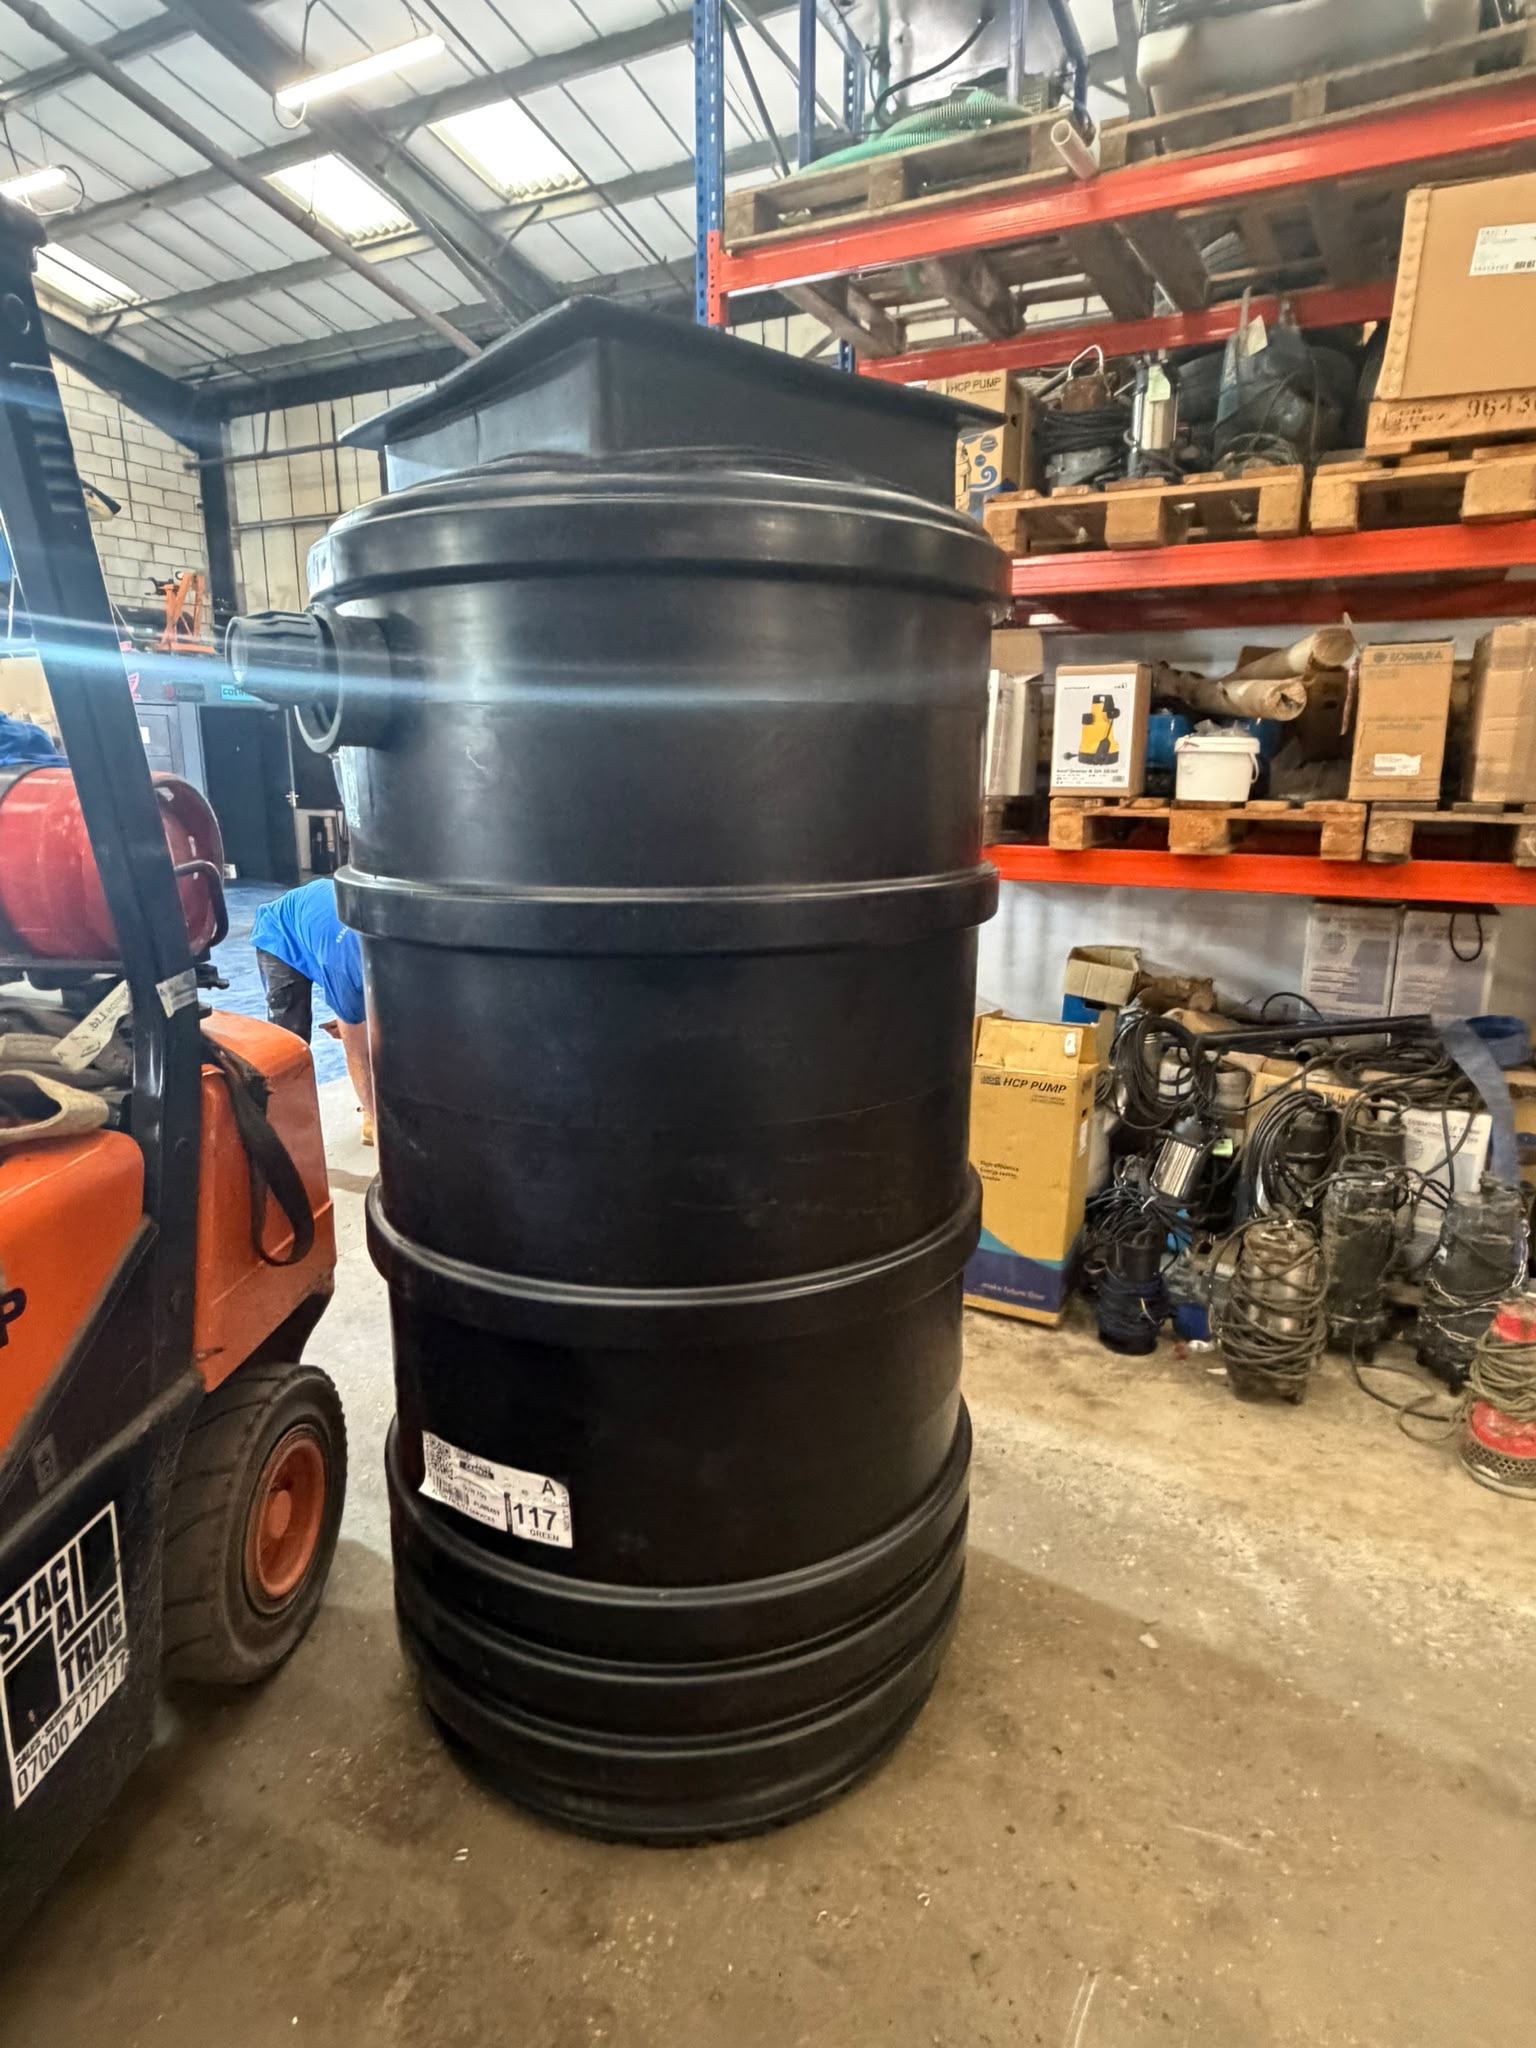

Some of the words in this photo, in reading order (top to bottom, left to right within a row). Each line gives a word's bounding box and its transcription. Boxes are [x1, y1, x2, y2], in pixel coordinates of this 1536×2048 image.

[951, 381, 971, 393] HCP
[973, 377, 1001, 389] PUMP
[1003, 1077, 1029, 1089] HCP
[1030, 1081, 1067, 1094] PUMP
[541, 1479, 556, 1497] A
[513, 1502, 557, 1531] 117
[529, 1529, 560, 1543] GREEN
[16, 1720, 69, 1798] 07000
